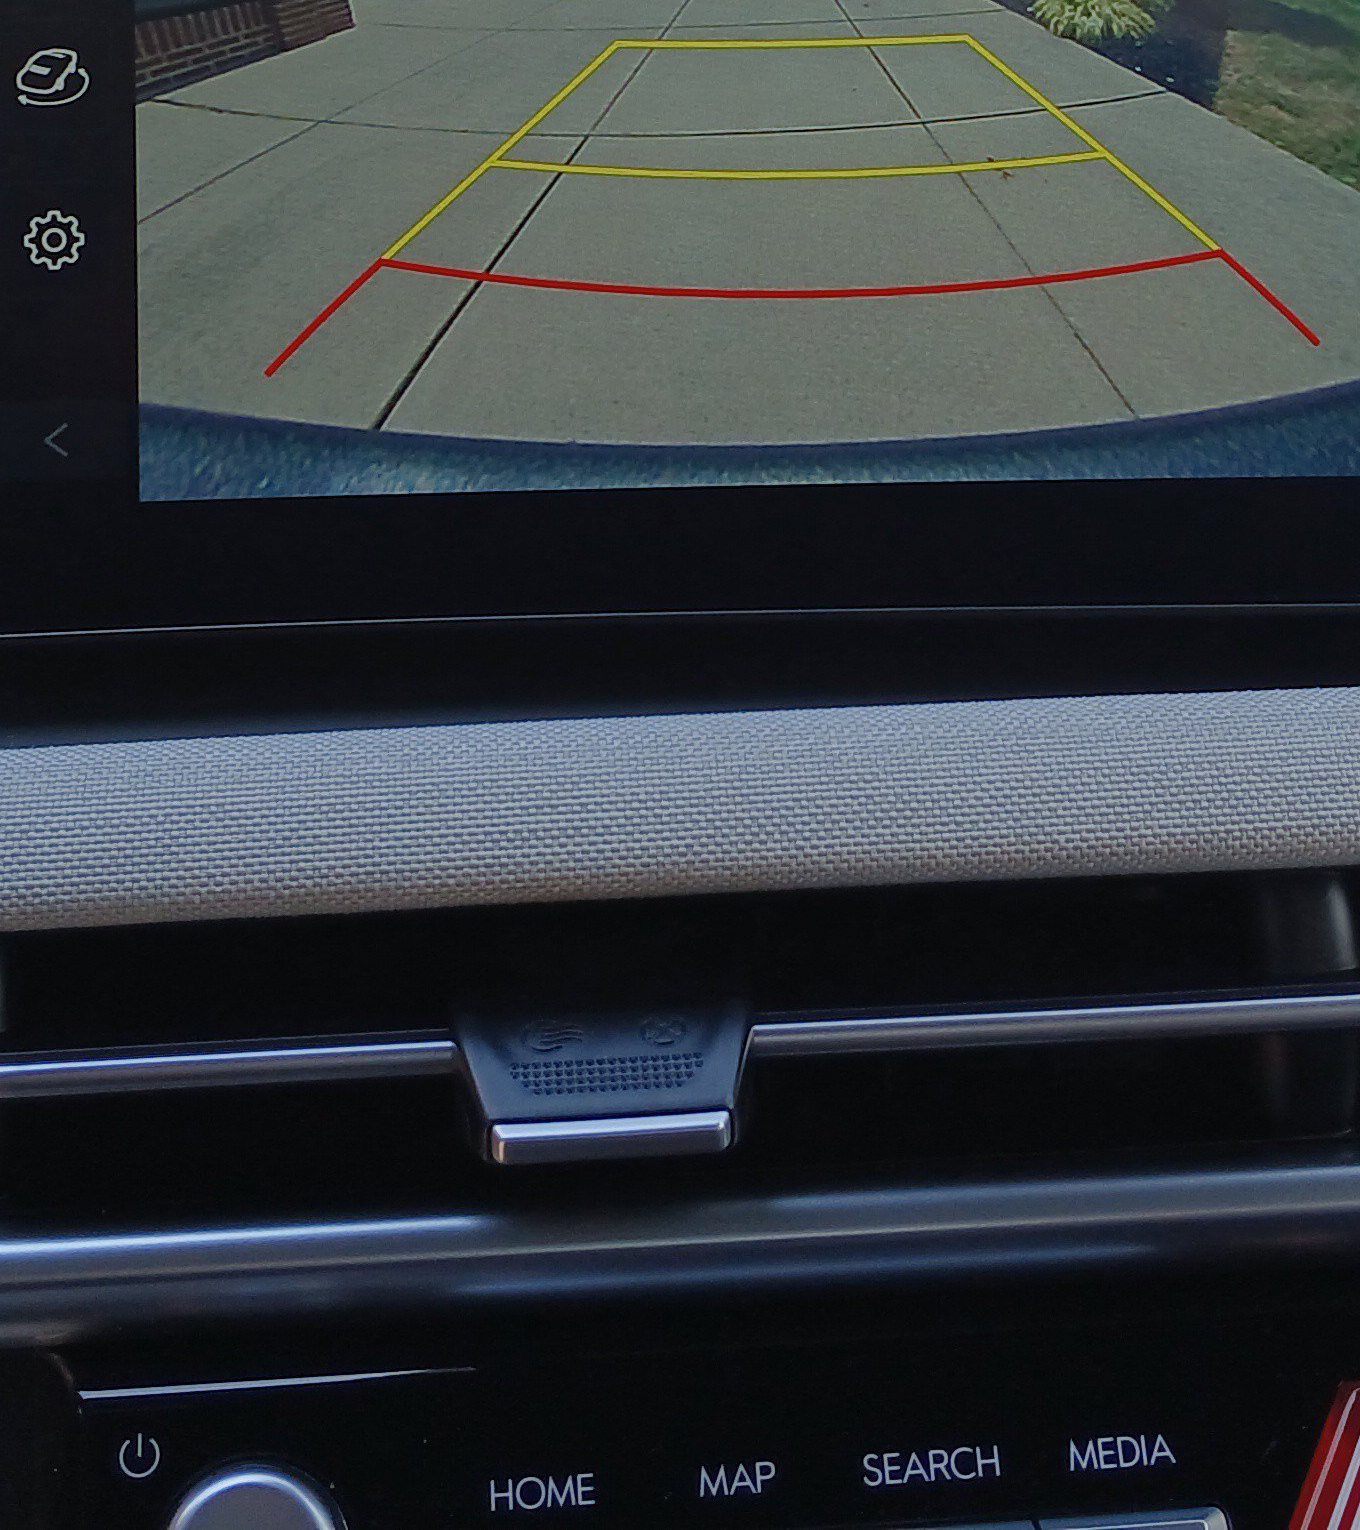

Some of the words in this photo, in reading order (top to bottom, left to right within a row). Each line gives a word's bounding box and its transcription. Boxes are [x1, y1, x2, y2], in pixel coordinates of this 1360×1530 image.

[863, 1444, 1001, 1486] SEARCH
[1069, 1434, 1177, 1471] MEDIA
[489, 1472, 596, 1512] HOME
[700, 1461, 776, 1498] MAP
